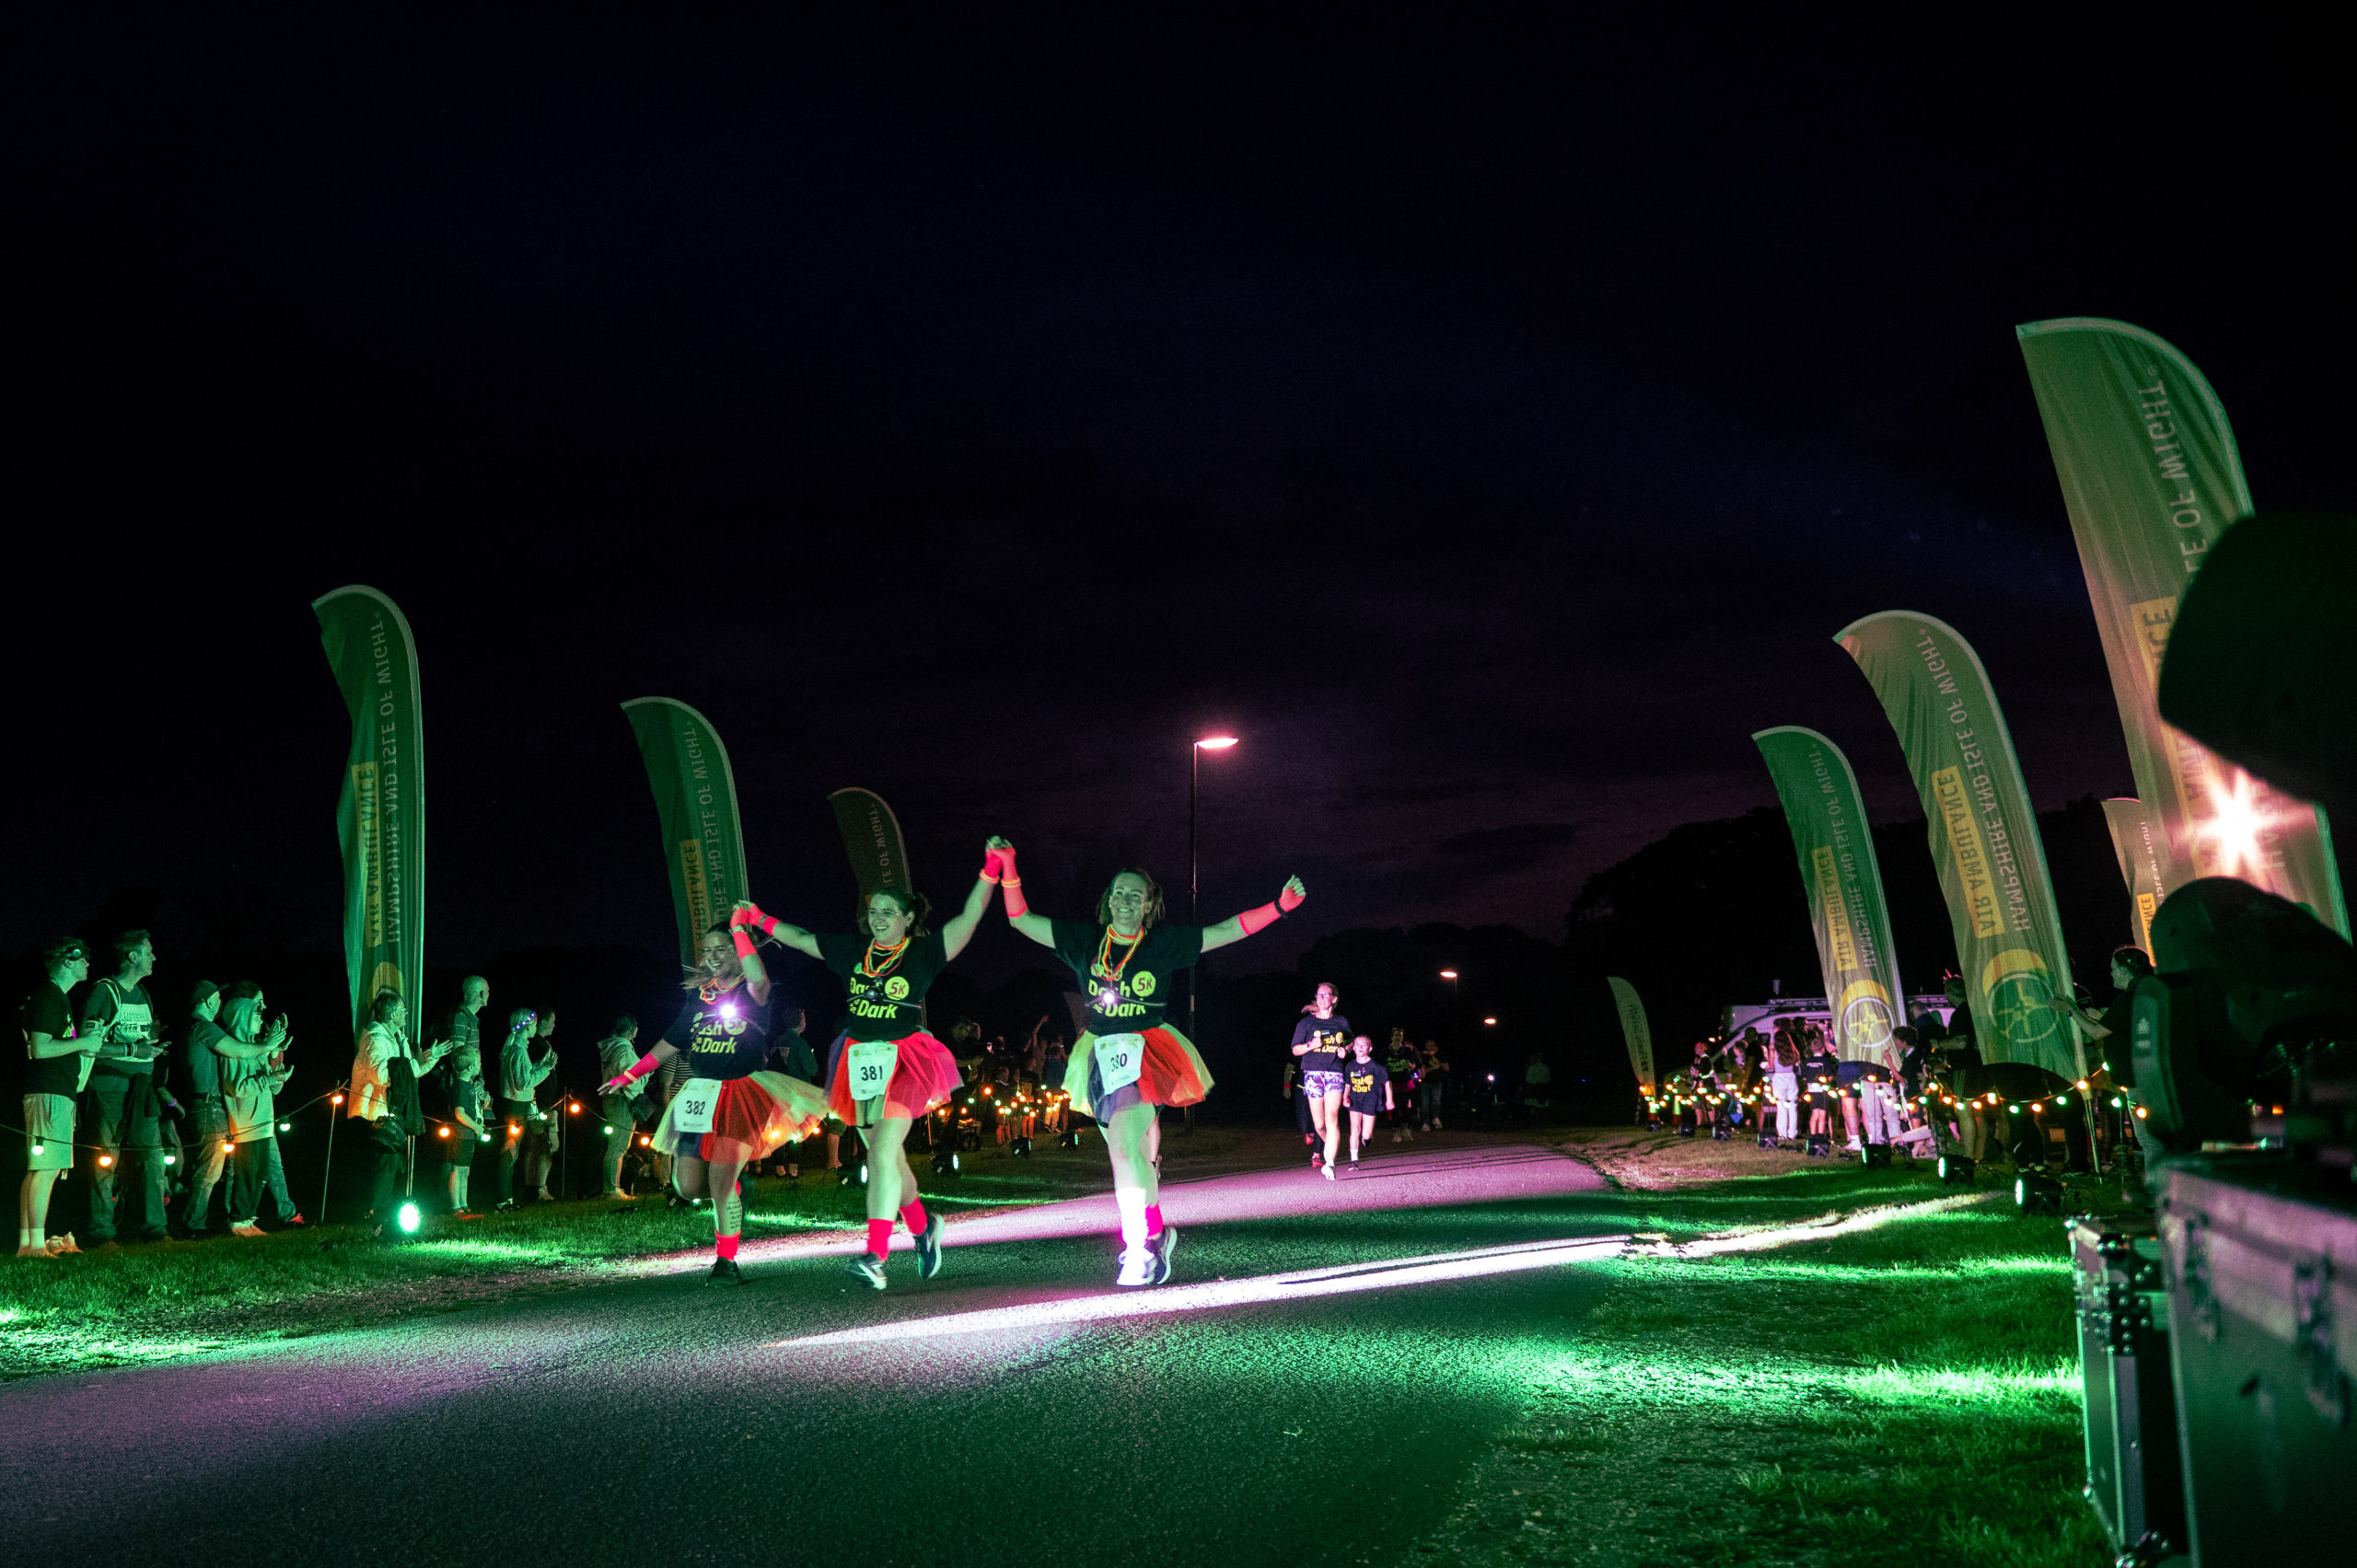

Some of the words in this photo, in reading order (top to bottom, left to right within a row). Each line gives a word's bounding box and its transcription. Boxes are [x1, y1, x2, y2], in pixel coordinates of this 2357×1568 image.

[888, 981, 906, 995] 5K
[1137, 977, 1153, 993] 5K
[856, 999, 899, 1019] Dark
[700, 1037, 737, 1054] Dark
[860, 1065, 883, 1082] 381
[685, 1100, 706, 1116] 382
